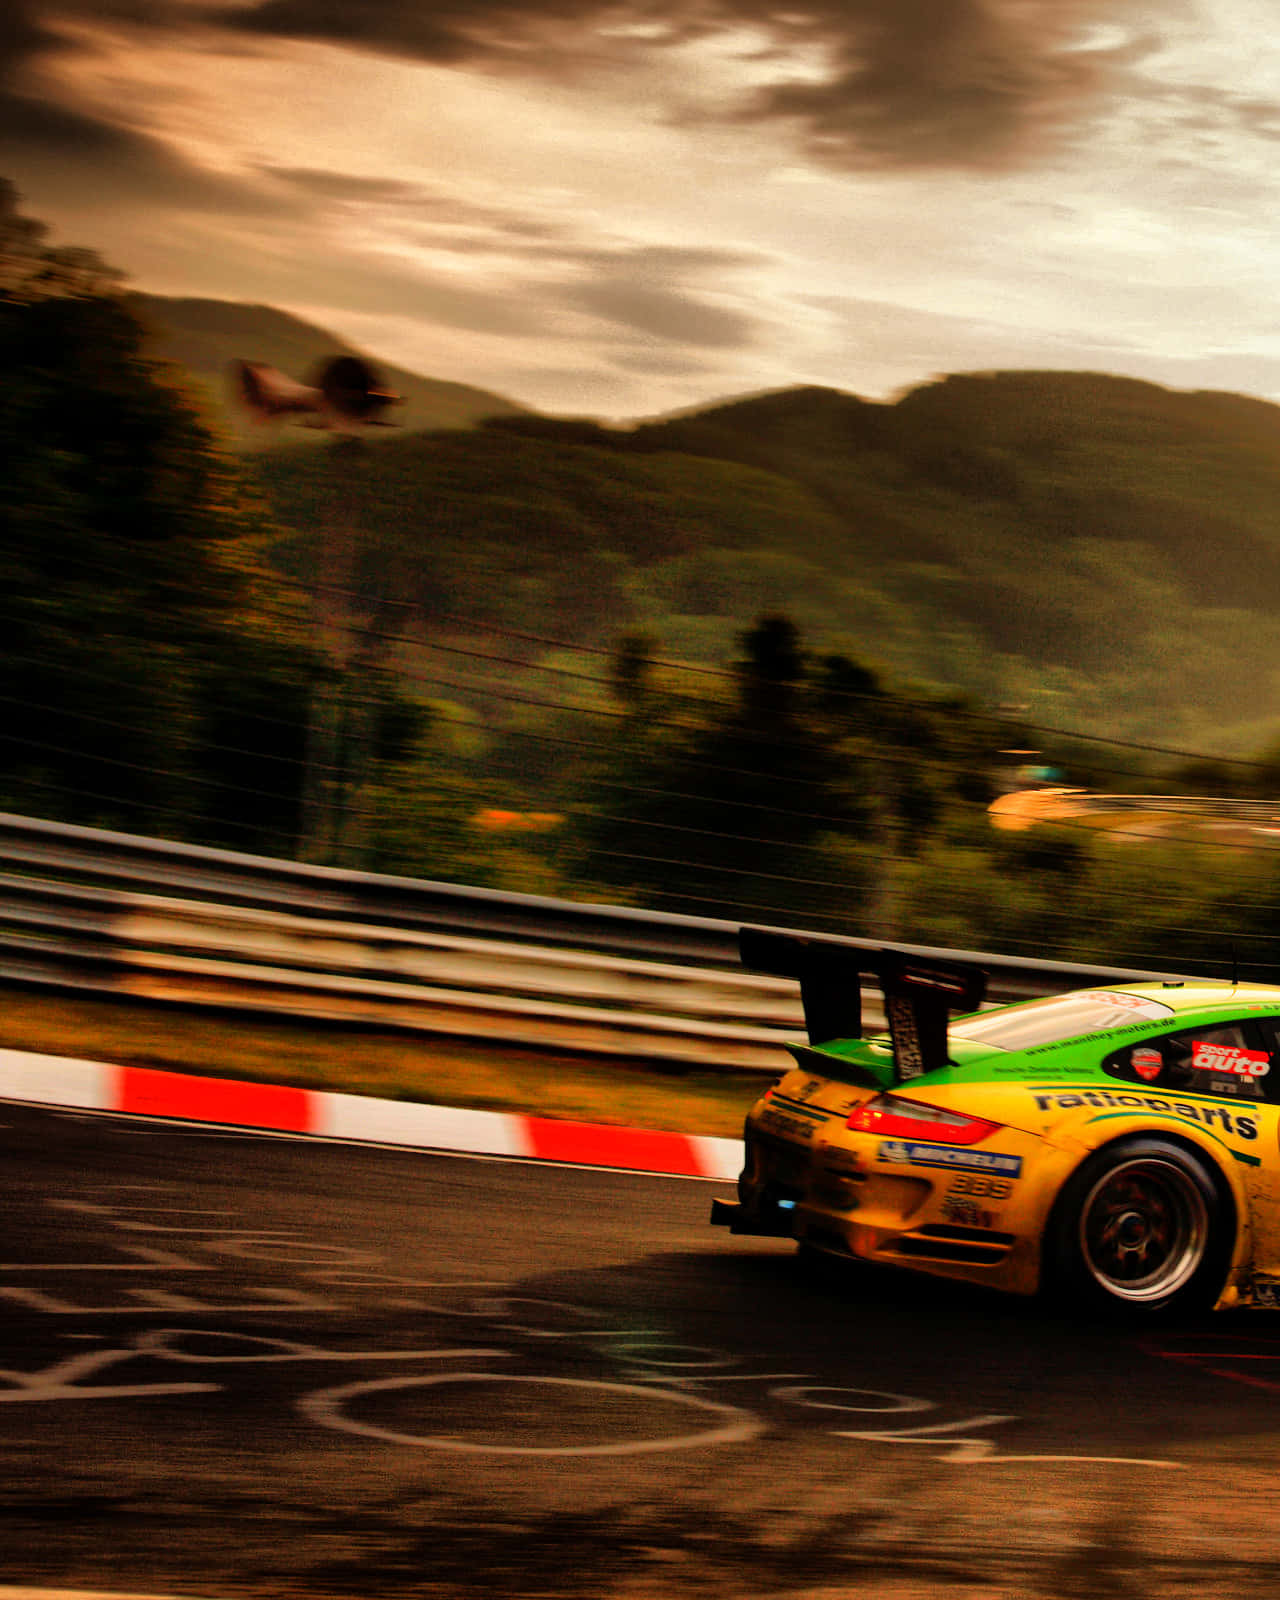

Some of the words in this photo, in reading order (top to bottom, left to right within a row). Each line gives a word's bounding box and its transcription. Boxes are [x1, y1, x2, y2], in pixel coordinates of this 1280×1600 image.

[1198, 1044, 1240, 1057] sport
[1193, 1053, 1270, 1076] auto
[1035, 1091, 1258, 1141] ratioparts
[911, 1146, 1018, 1171] MICHELIN
[947, 1174, 1012, 1200] BBS
